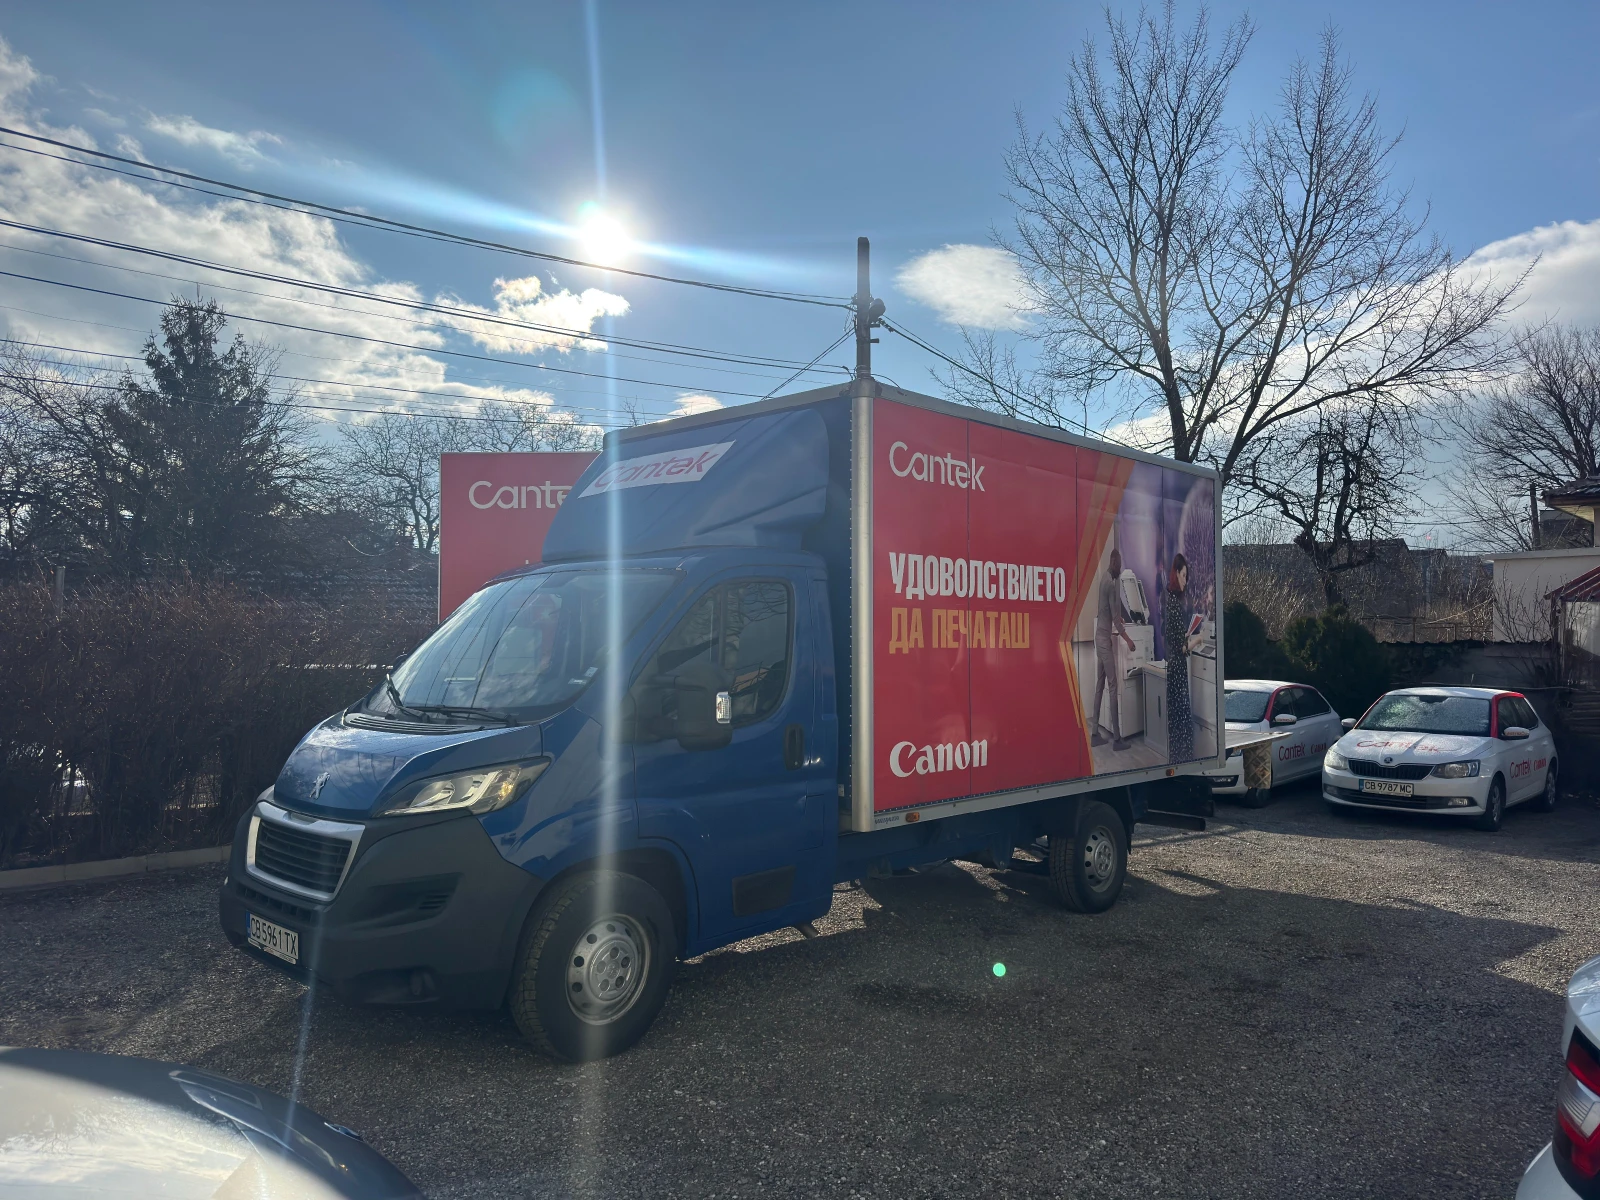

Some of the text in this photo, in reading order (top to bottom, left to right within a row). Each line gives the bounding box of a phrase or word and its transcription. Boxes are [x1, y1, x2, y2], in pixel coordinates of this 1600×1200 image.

[594, 451, 719, 488] Cantek
[889, 441, 986, 492] Cantek
[468, 480, 573, 510] Cante
[888, 551, 1066, 603] УДОВОЛСТВИЕТО
[888, 607, 1030, 654] ДА ПЕЧАТАШ
[889, 739, 988, 778] Canon
[1278, 743, 1306, 762] Cantek
[1364, 781, 1412, 794] CB 9787 MC
[250, 917, 297, 956] CB 5961 TX
